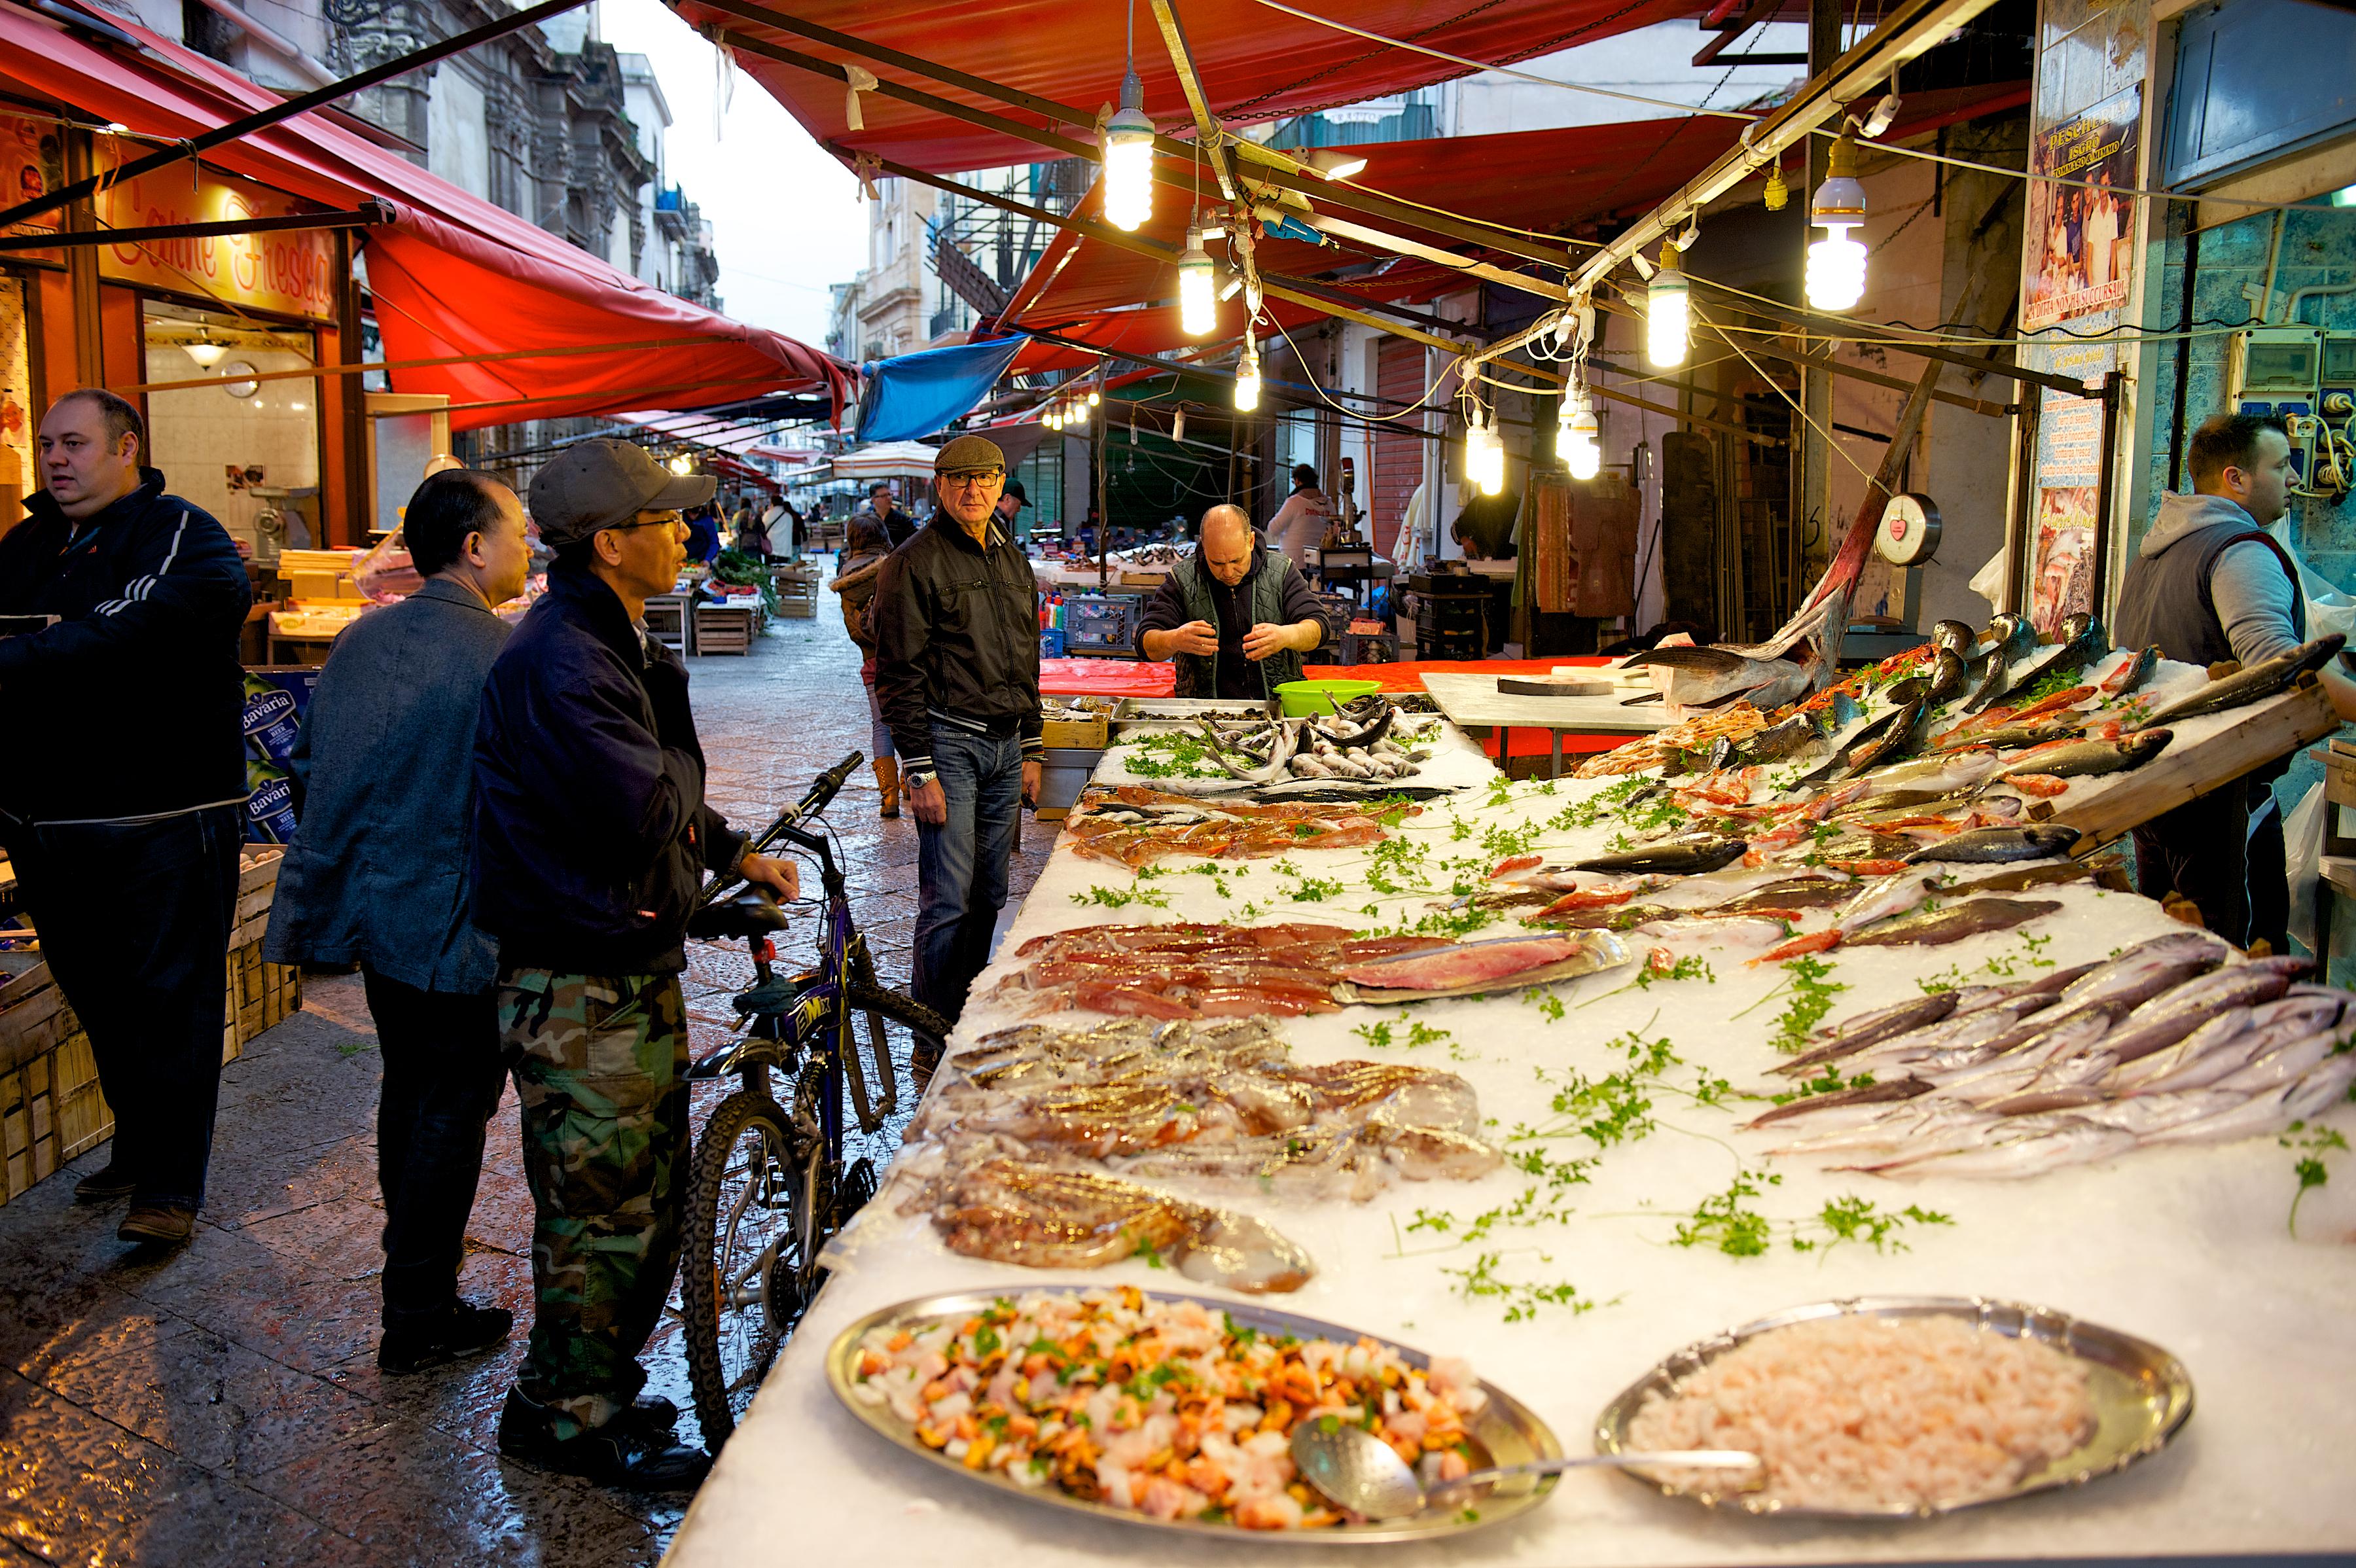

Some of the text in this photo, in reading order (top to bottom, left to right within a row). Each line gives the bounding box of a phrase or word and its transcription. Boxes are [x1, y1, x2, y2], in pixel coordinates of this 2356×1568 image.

[2048, 101, 2130, 152] PESCHERIA
[2052, 141, 2120, 178] TOMMASO & MIMMO
[2068, 132, 2100, 162] ISGRÒ
[225, 194, 332, 304] Fresca
[2036, 300, 2054, 317] DITTA
[2056, 295, 2069, 312] NON
[2071, 291, 2079, 308] HA
[2080, 279, 2125, 306] SUCCURSALI
[2075, 413, 2092, 425] seppia
[2075, 446, 2092, 457] fresca
[243, 696, 291, 729] Bavaria
[270, 725, 286, 738] BEER
[249, 783, 290, 815] Bavari
